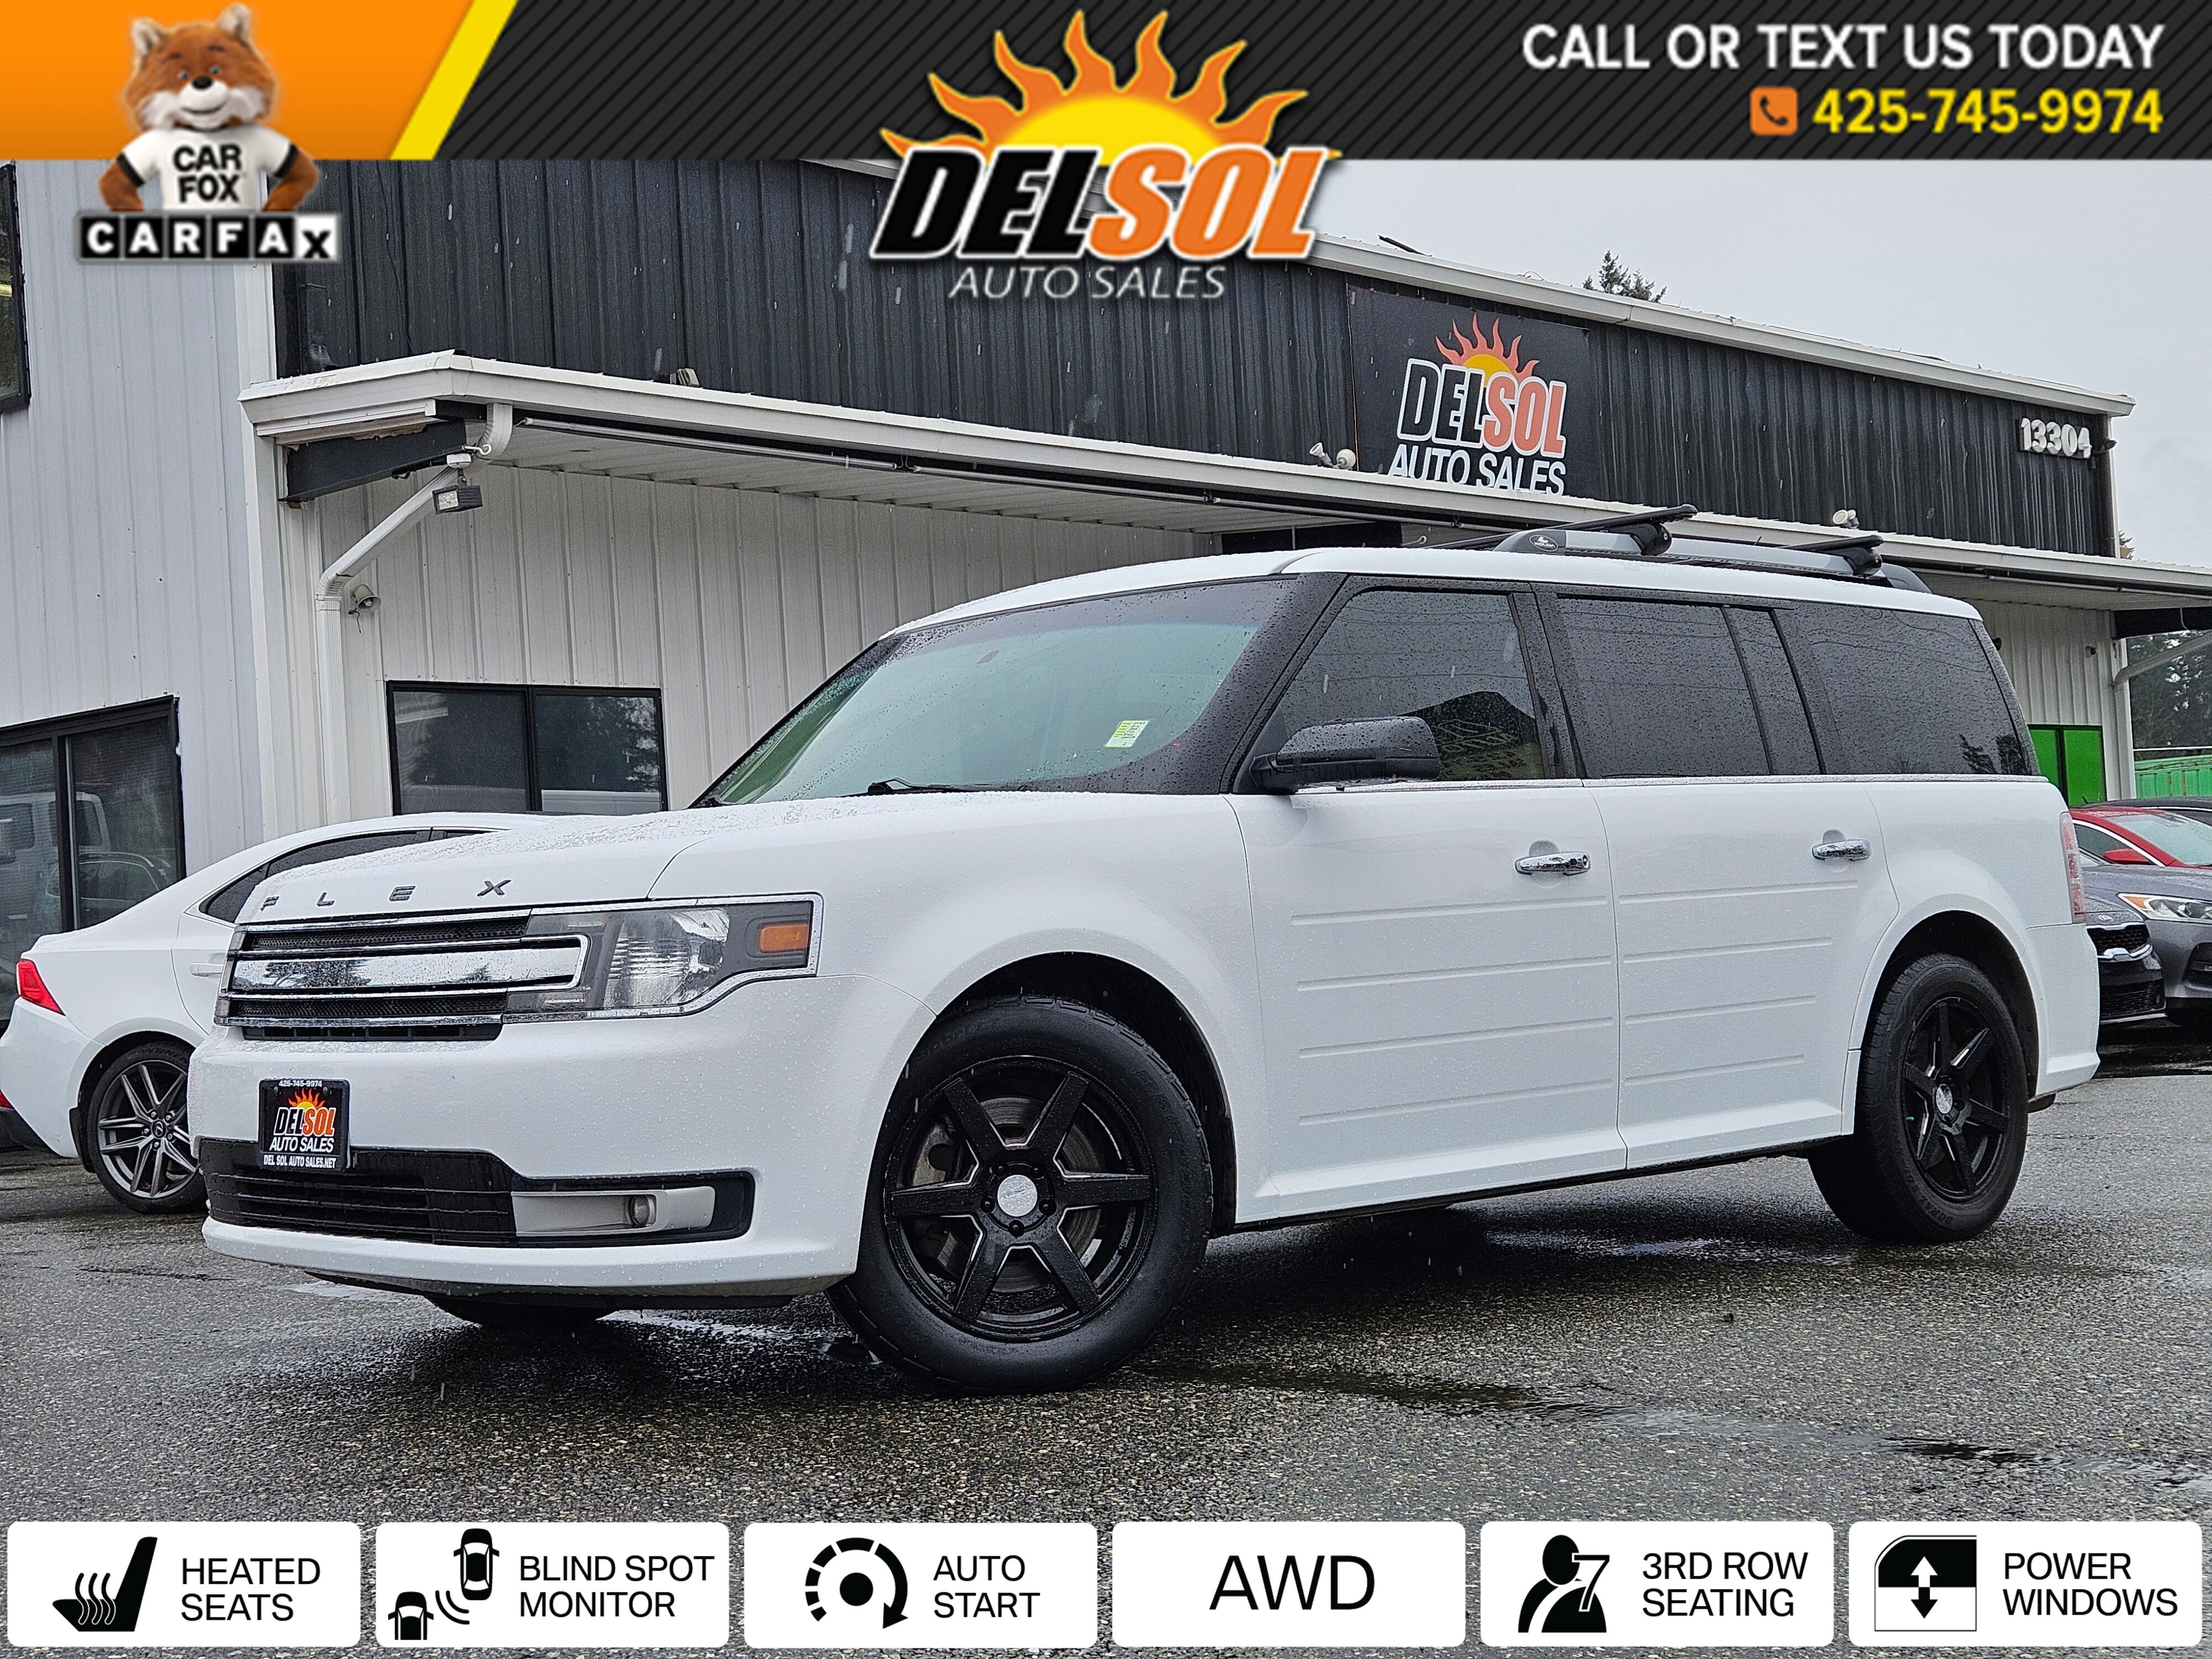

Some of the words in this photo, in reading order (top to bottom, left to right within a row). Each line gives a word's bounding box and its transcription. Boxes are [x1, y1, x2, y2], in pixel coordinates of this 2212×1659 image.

[2020, 418, 2092, 459] 13304
[1389, 444, 1471, 484] AUTO
[1476, 452, 1566, 496] SALES
[260, 879, 512, 911] FLEX
[269, 1136, 299, 1152] AUTO
[299, 1138, 335, 1153] SALES
[263, 1154, 275, 1165] DEL
[276, 1155, 288, 1166] SOL
[289, 1155, 304, 1167] AUTO
[305, 1156, 336, 1168] SALES.NET
